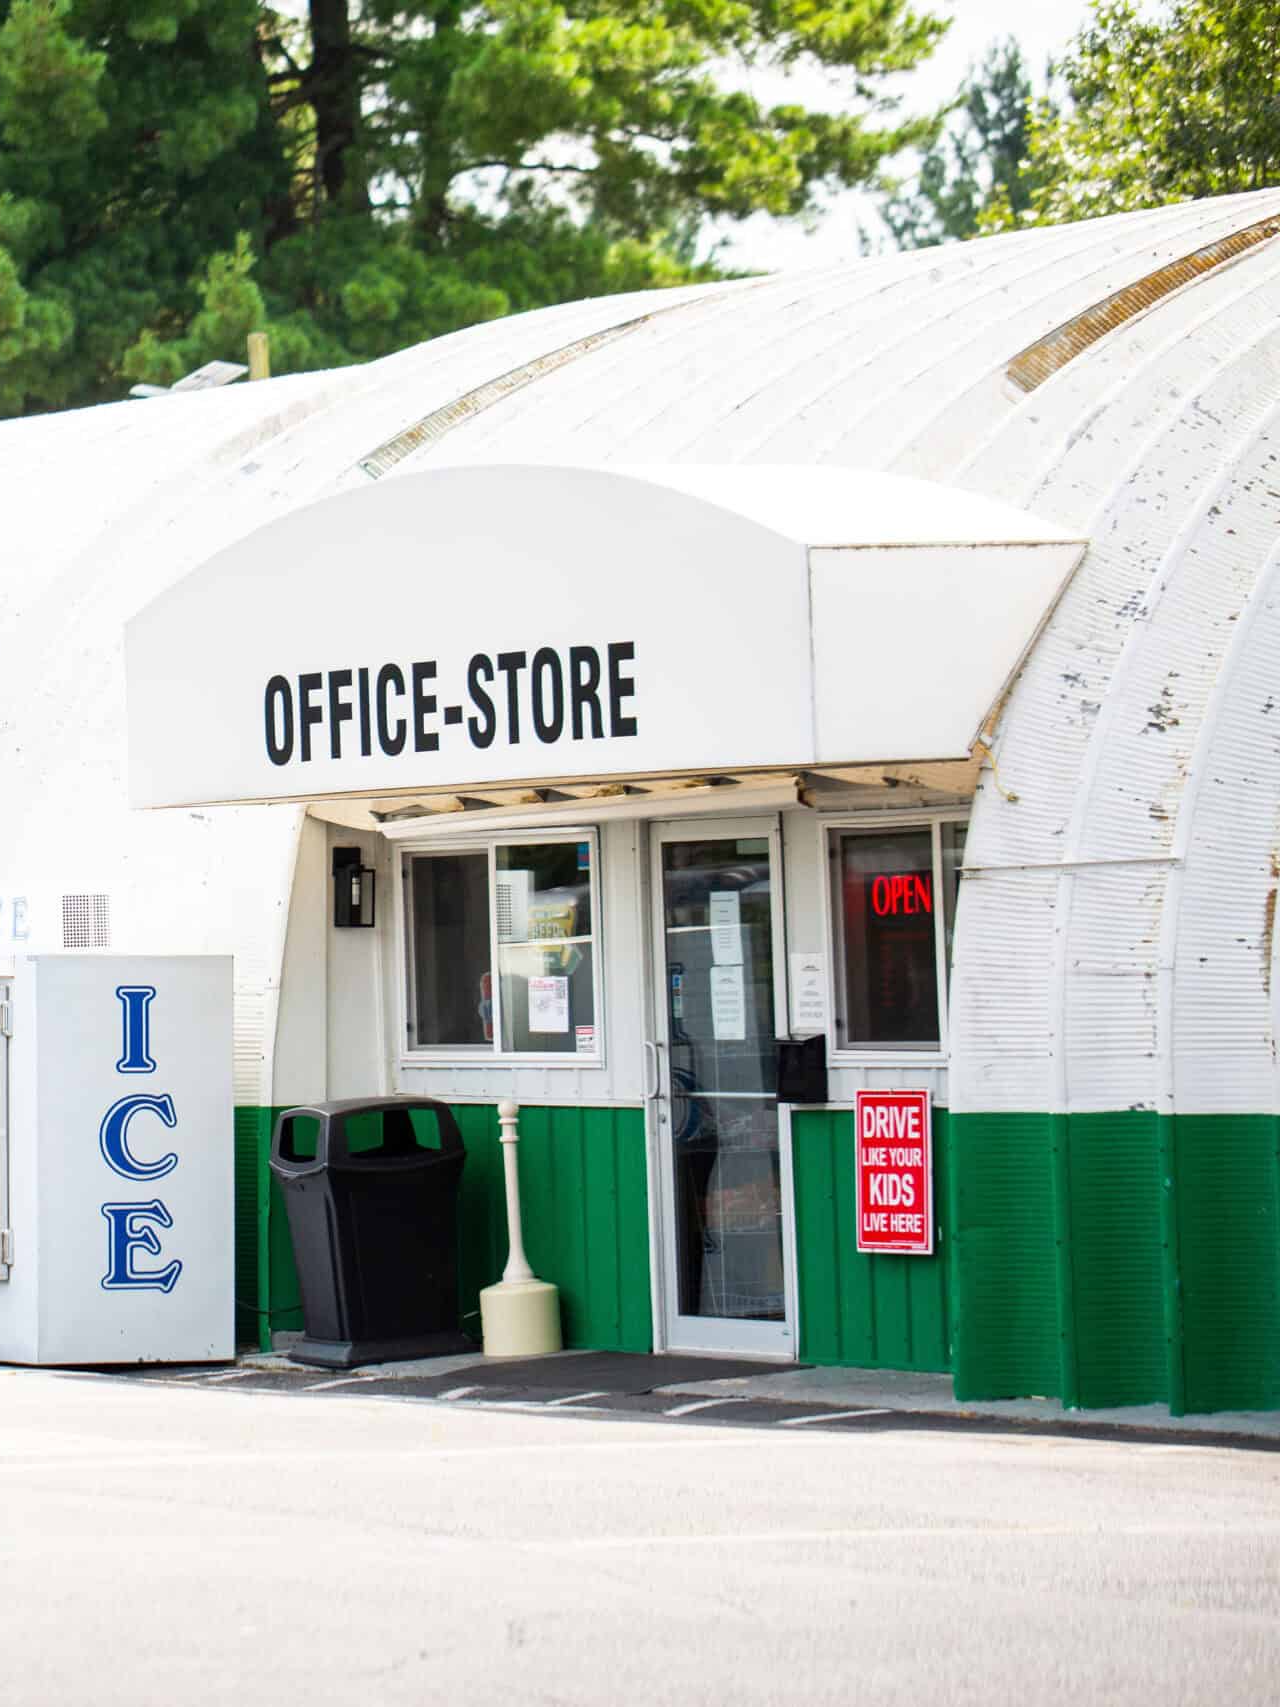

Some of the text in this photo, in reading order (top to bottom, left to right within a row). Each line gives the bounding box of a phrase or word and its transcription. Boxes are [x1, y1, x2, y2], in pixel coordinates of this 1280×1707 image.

[263, 640, 638, 767] OFFICE-STORE
[872, 874, 932, 916] OPEN
[99, 985, 183, 1294] ICE
[862, 1105, 921, 1140] DRIVE
[862, 1147, 923, 1168] LIKE YOUR
[869, 1172, 915, 1207] KIDS
[863, 1213, 923, 1233] LIVE HERE
